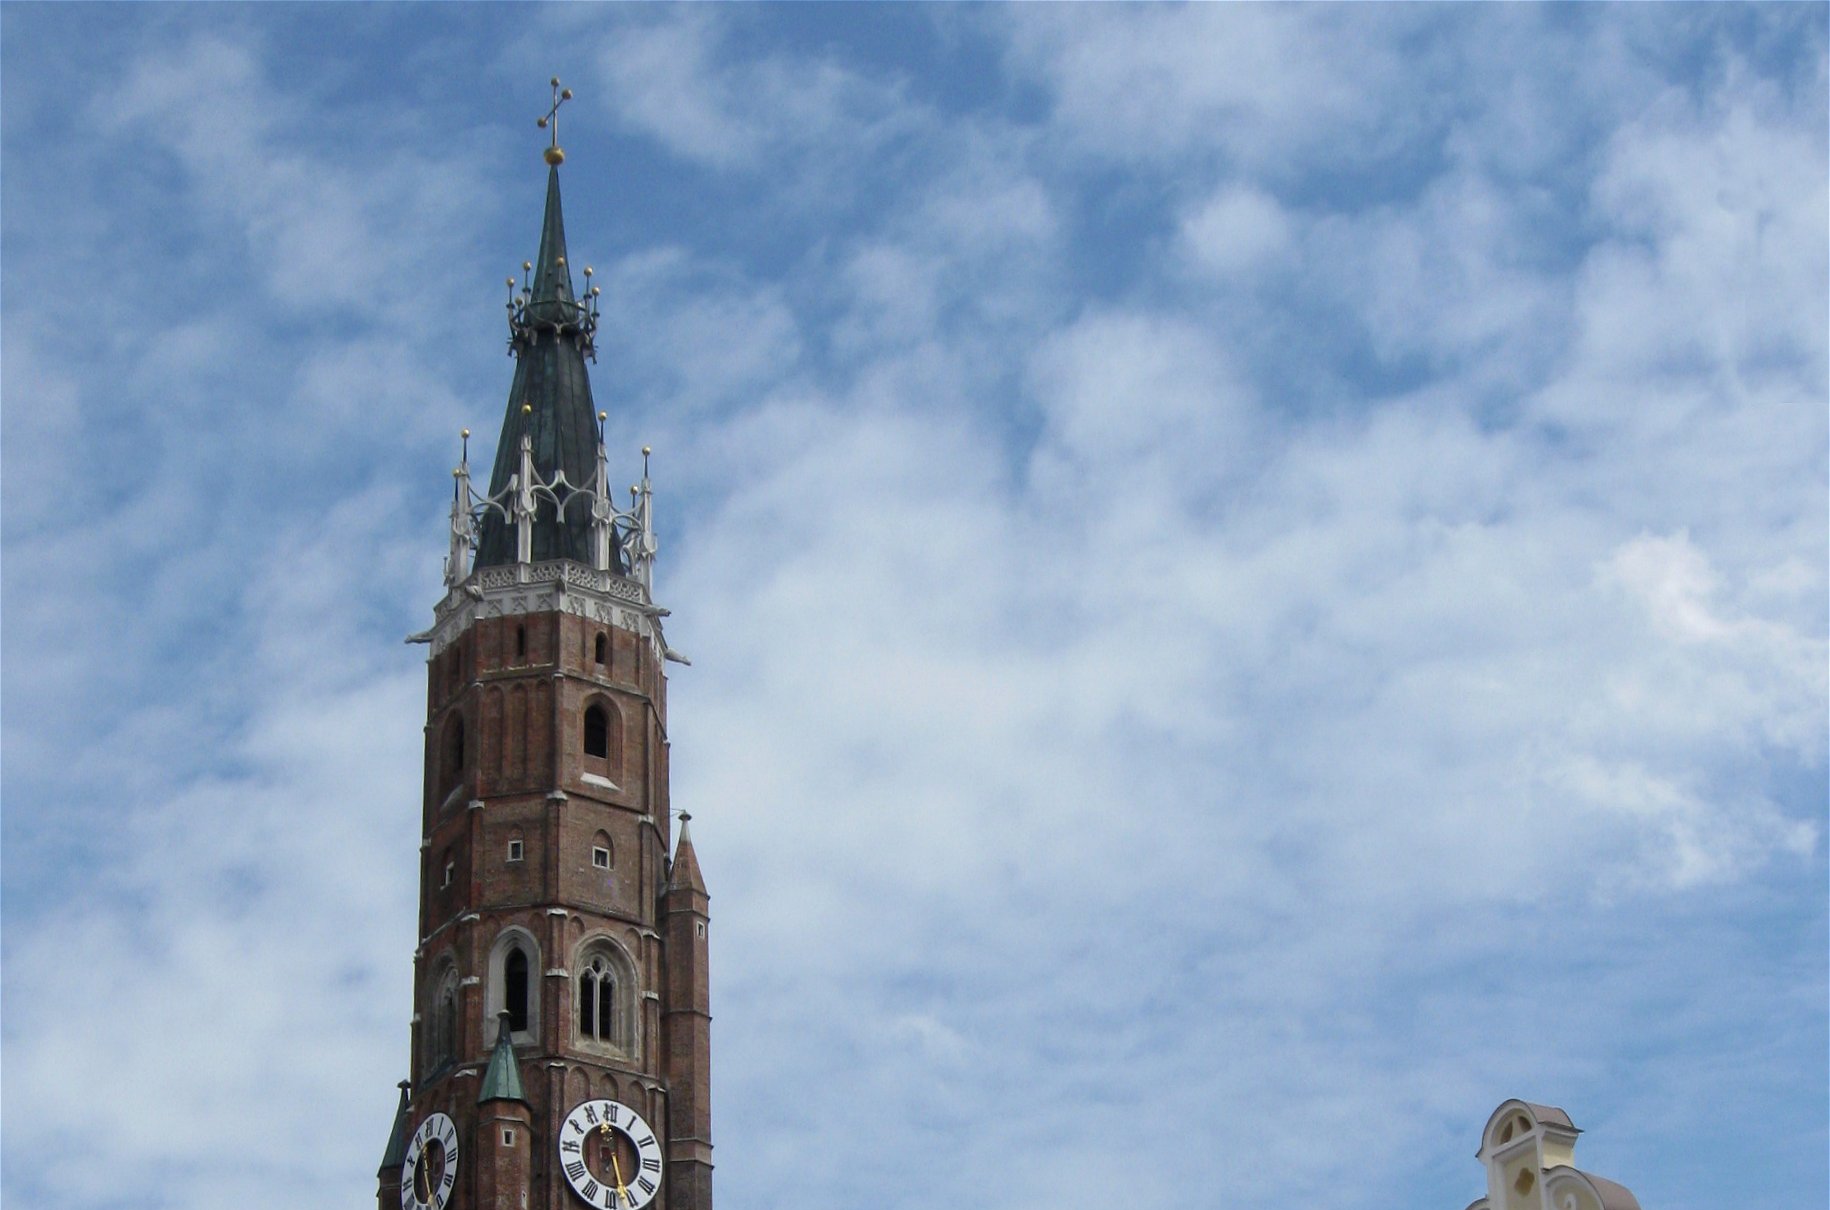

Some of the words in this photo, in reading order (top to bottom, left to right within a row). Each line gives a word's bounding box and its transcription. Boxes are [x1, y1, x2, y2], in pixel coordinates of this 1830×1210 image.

[626, 1115, 637, 1131] I
[638, 1135, 655, 1148] II
[642, 1158, 660, 1173] III
